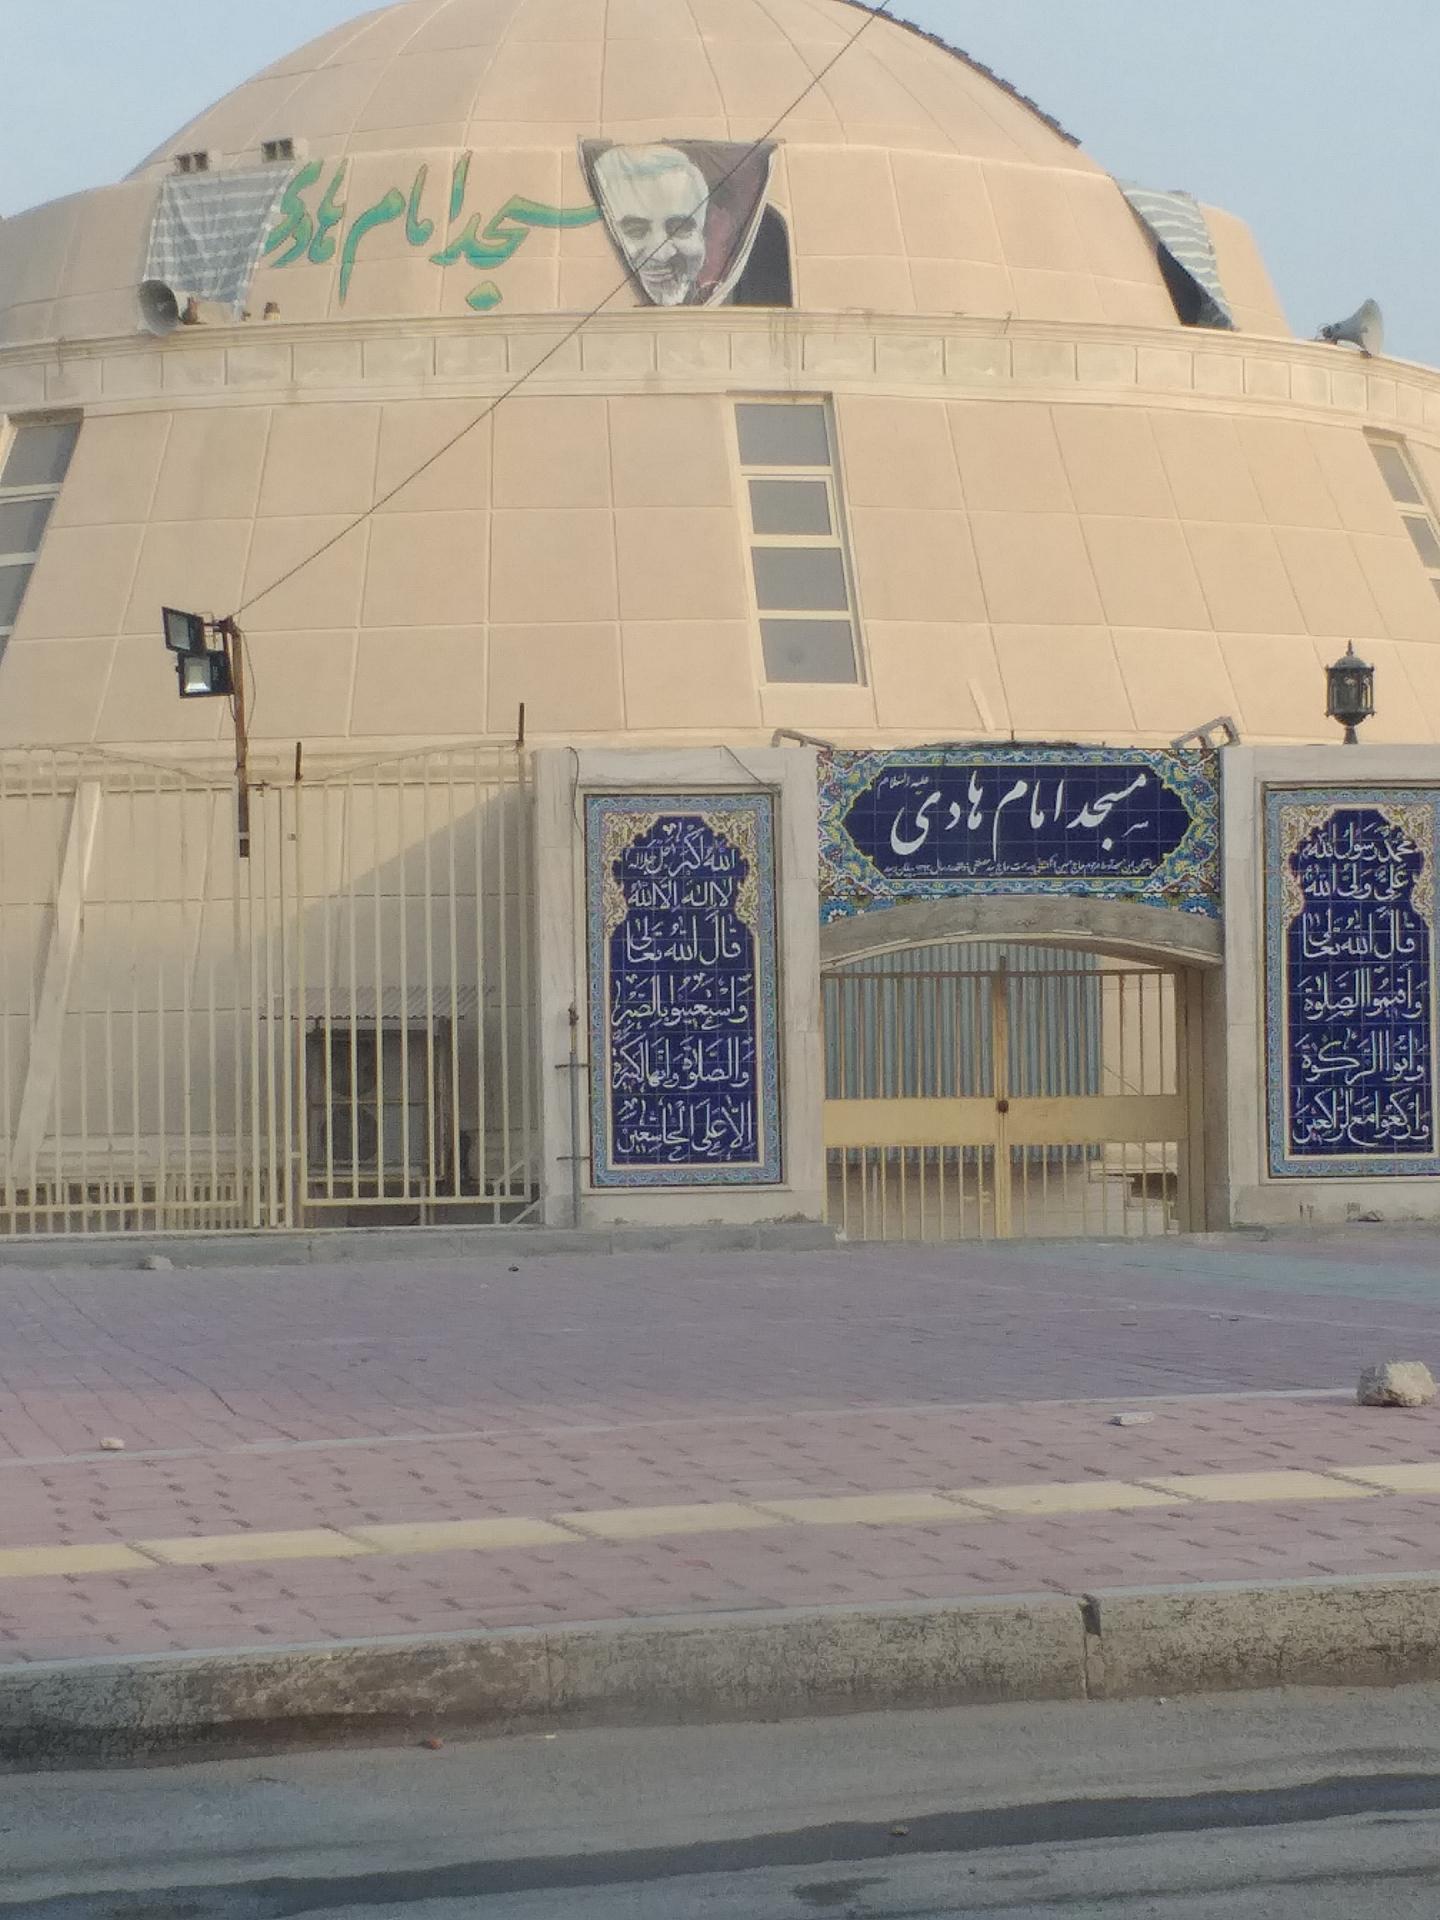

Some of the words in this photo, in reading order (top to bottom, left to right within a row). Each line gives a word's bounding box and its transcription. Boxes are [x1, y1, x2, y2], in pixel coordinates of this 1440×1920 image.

[338, 150, 471, 308] امام
[429, 195, 602, 312] سجد
[891, 770, 984, 856] هادی
[992, 779, 1065, 862] امام
[1066, 773, 1147, 851] مسجد
